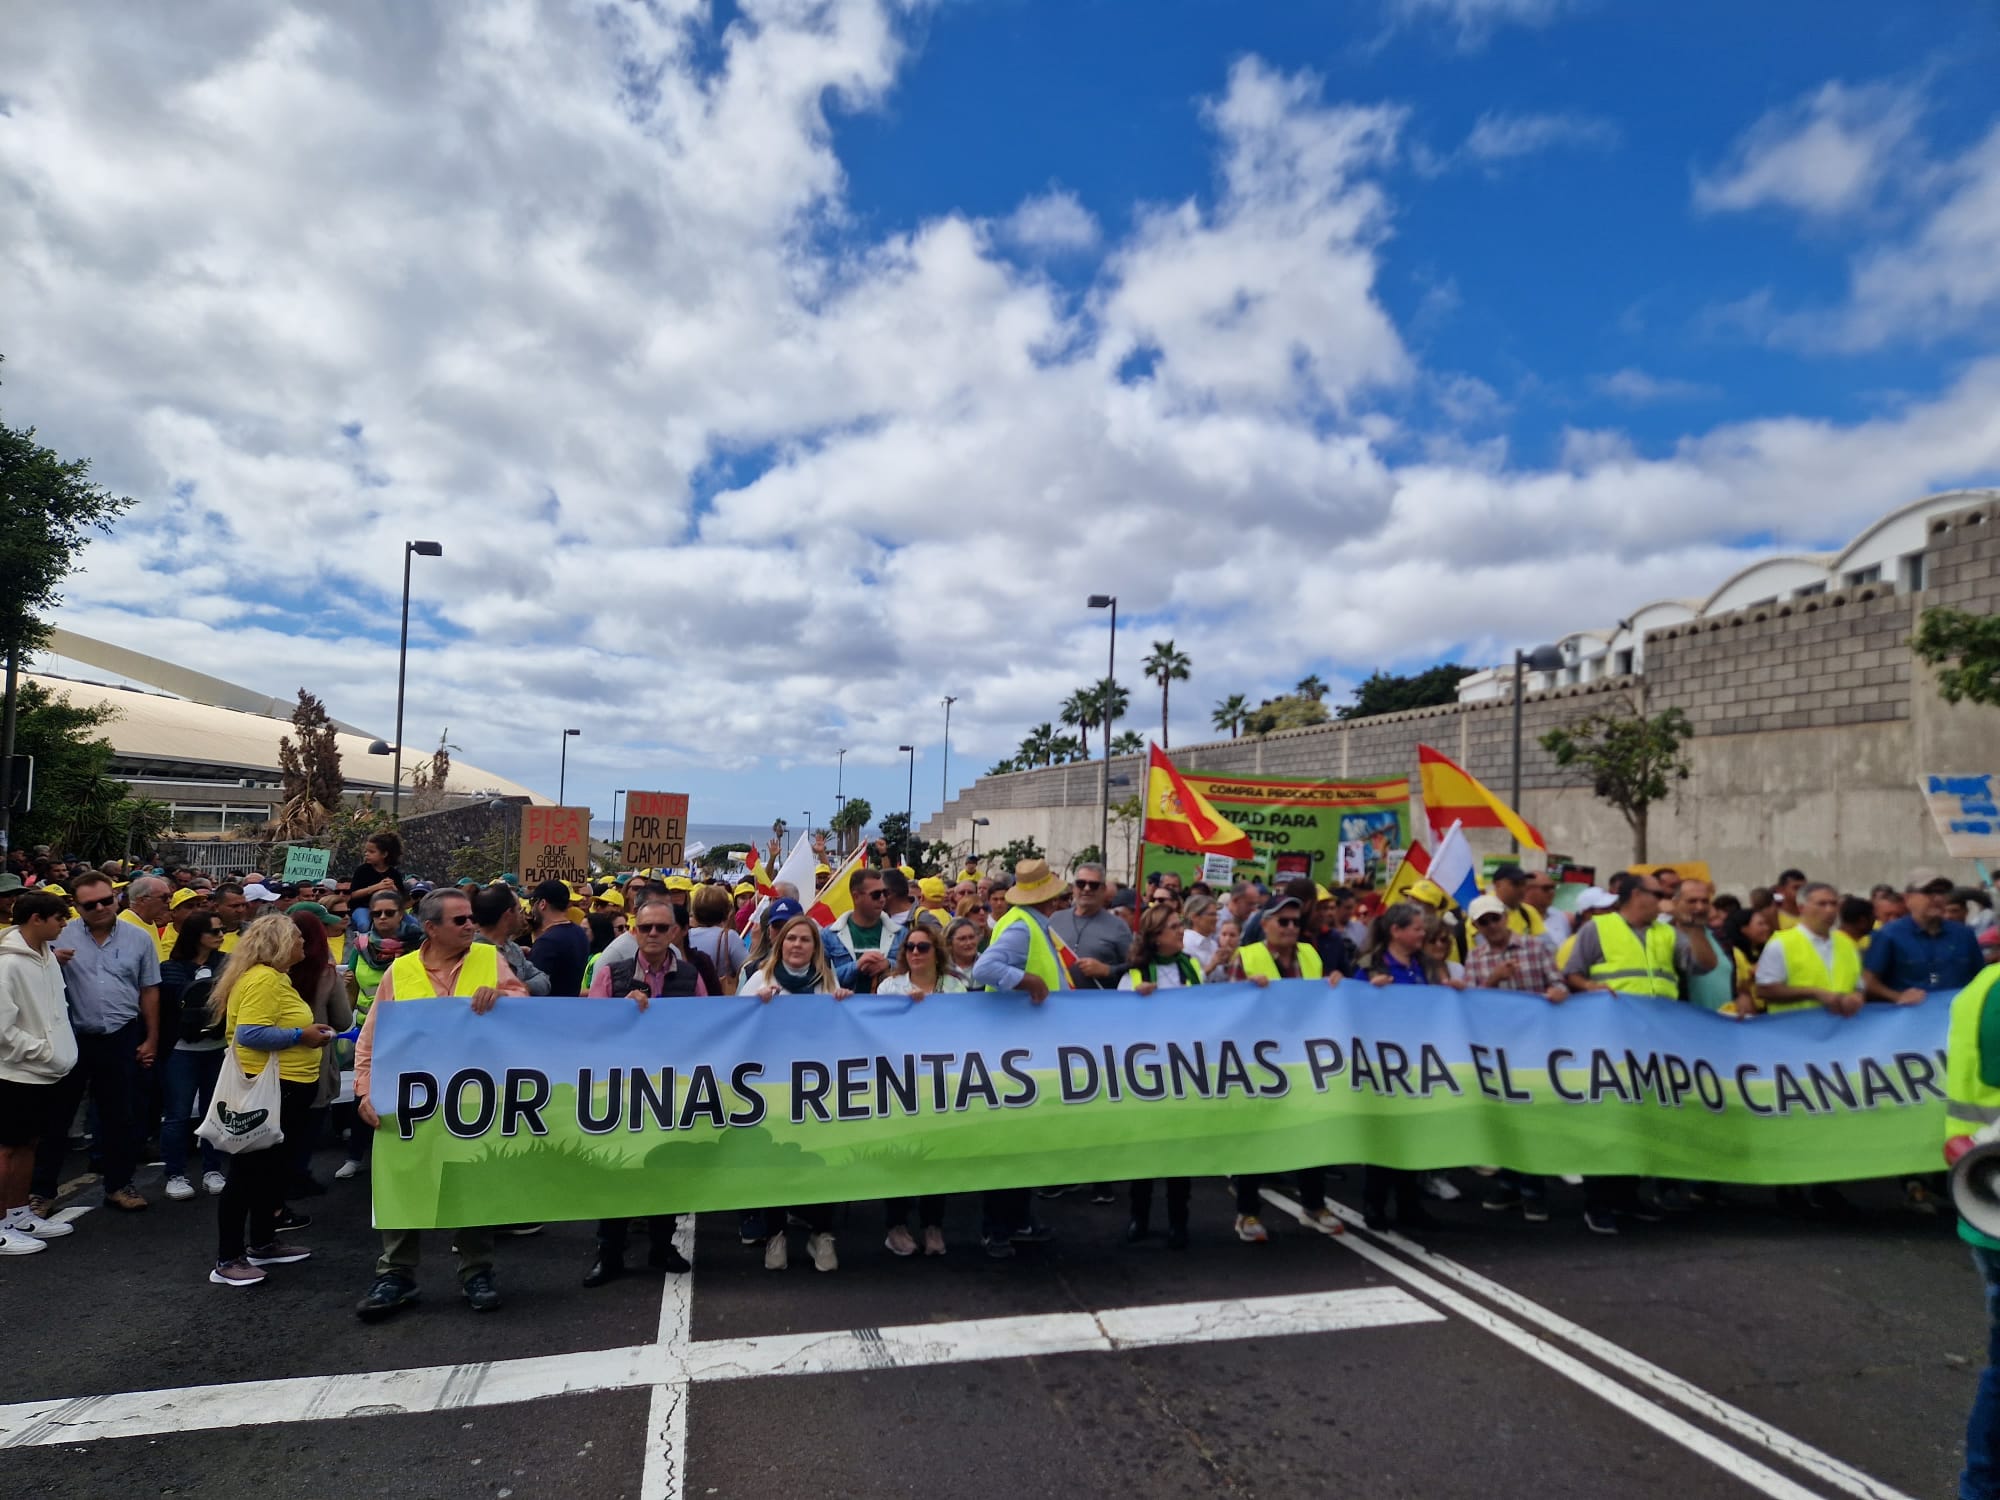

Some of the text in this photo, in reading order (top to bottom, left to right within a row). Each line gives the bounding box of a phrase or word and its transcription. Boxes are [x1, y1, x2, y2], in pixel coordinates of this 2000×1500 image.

[1209, 784, 1263, 797] COMPRA
[1267, 787, 1334, 799] PRODUCTO
[630, 792, 687, 817] JUNTOS
[529, 809, 581, 828] PICA
[632, 816, 683, 840] POR EL
[1270, 812, 1318, 828] PARA
[528, 828, 580, 846] PICA
[543, 844, 568, 856] QUE
[626, 841, 682, 866] CAMPO
[396, 1067, 551, 1140] POR
[576, 1061, 768, 1134] UNAS
[789, 1048, 1038, 1124] RENTAS
[1056, 1039, 1292, 1105] DIGNAS
[1303, 1035, 1463, 1097] PARA
[1469, 1041, 1532, 1103] EL
[1546, 1046, 1726, 1114] CAMPO
